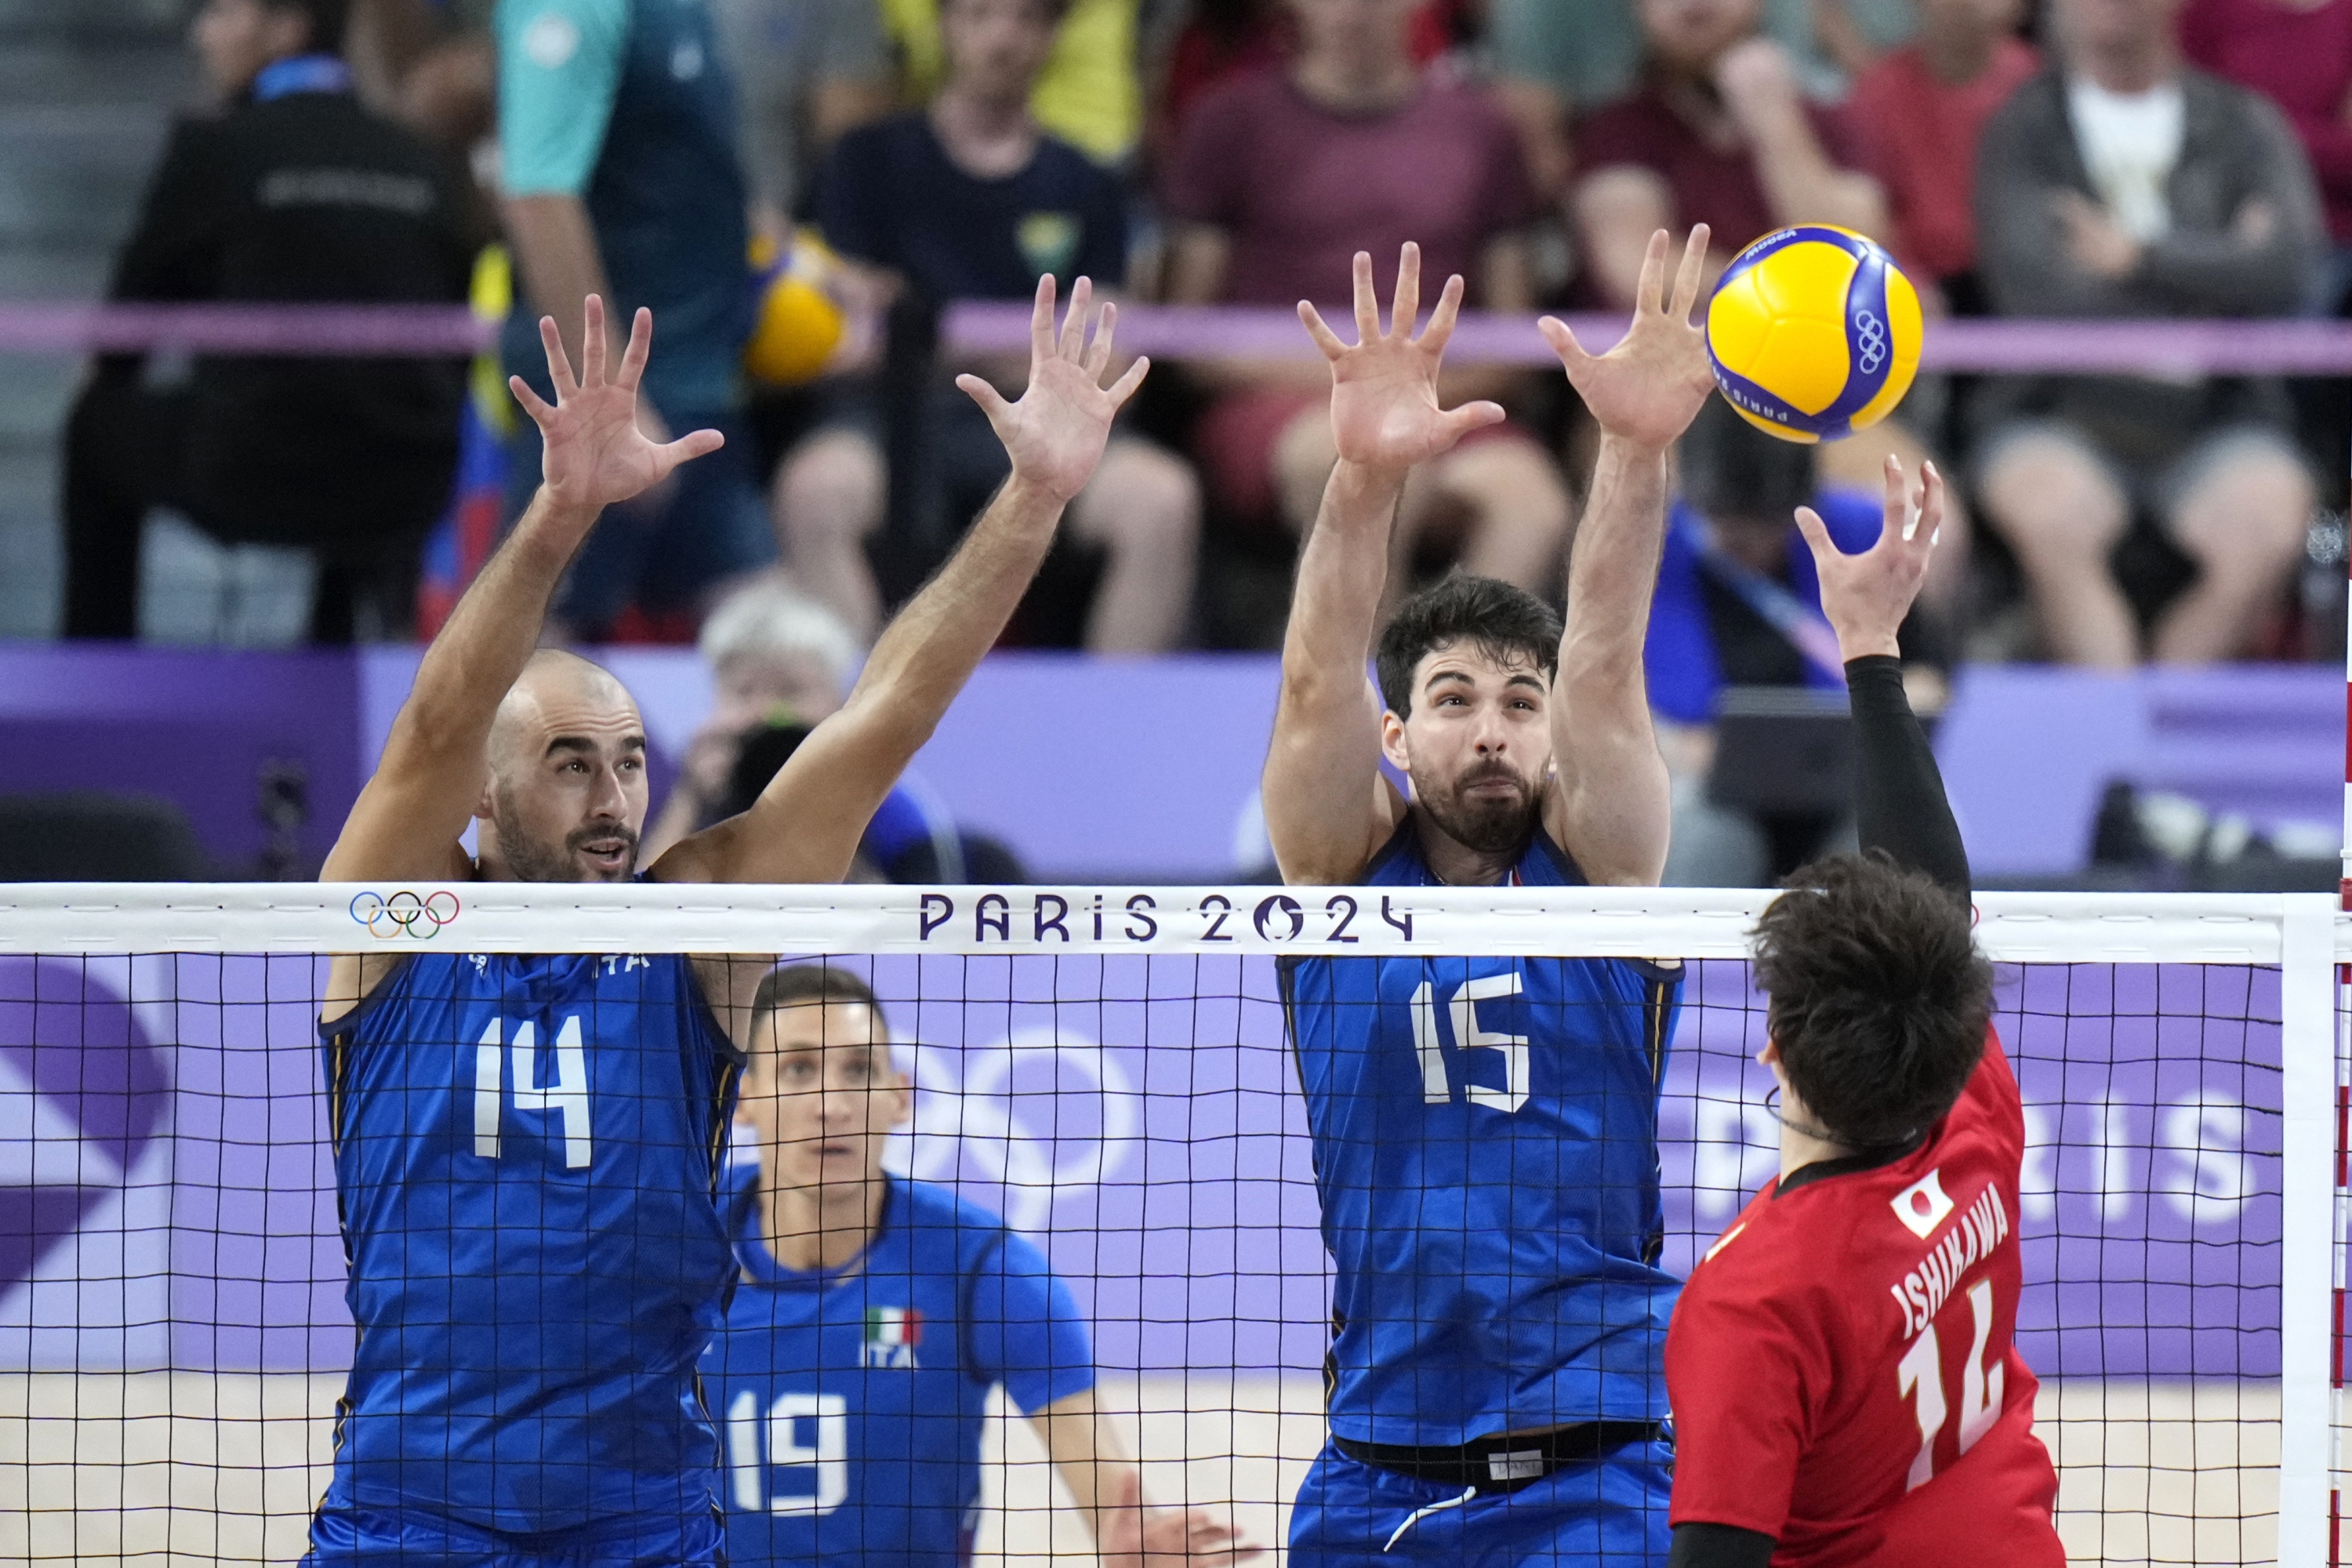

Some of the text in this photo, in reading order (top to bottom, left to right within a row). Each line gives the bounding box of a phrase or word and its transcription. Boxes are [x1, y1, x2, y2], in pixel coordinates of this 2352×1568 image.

[1733, 389, 1788, 423] PARIS
[920, 894, 1412, 942] PARIS 2024
[474, 1015, 591, 1168] 14
[1410, 971, 1530, 1113] 15
[1692, 1090, 2256, 1223] PIS
[1890, 1181, 2009, 1340] ISHIKAWA
[858, 1341, 920, 1371] ITA
[728, 1391, 848, 1517] 19
